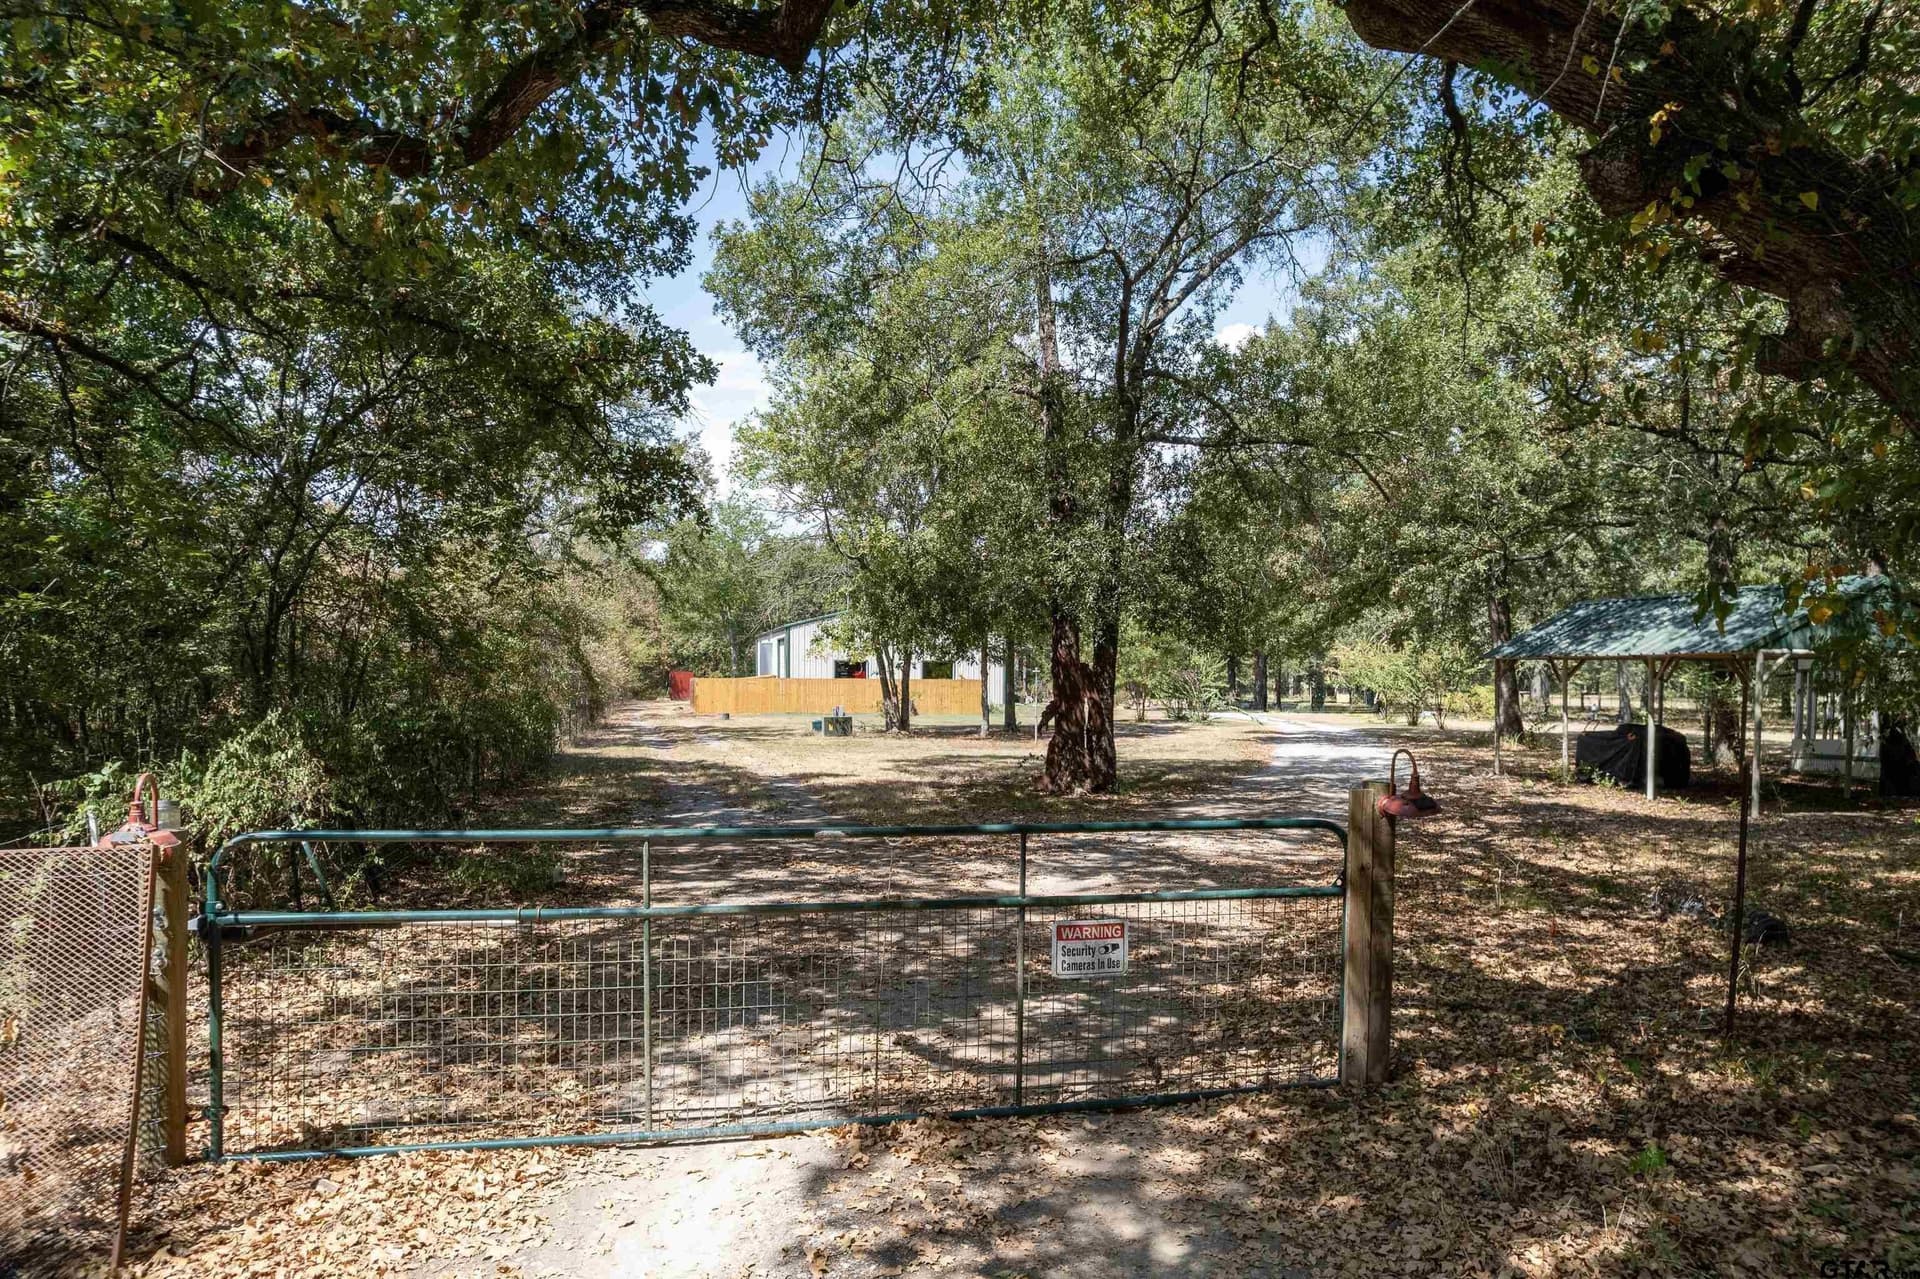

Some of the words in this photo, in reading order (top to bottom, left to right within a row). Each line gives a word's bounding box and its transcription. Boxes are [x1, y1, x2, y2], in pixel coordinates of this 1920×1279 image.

[1061, 925, 1122, 939] WARNING
[1061, 944, 1096, 958] Security
[1061, 959, 1096, 972] Cameras
[1097, 958, 1105, 969] In
[1107, 958, 1121, 969] Use
